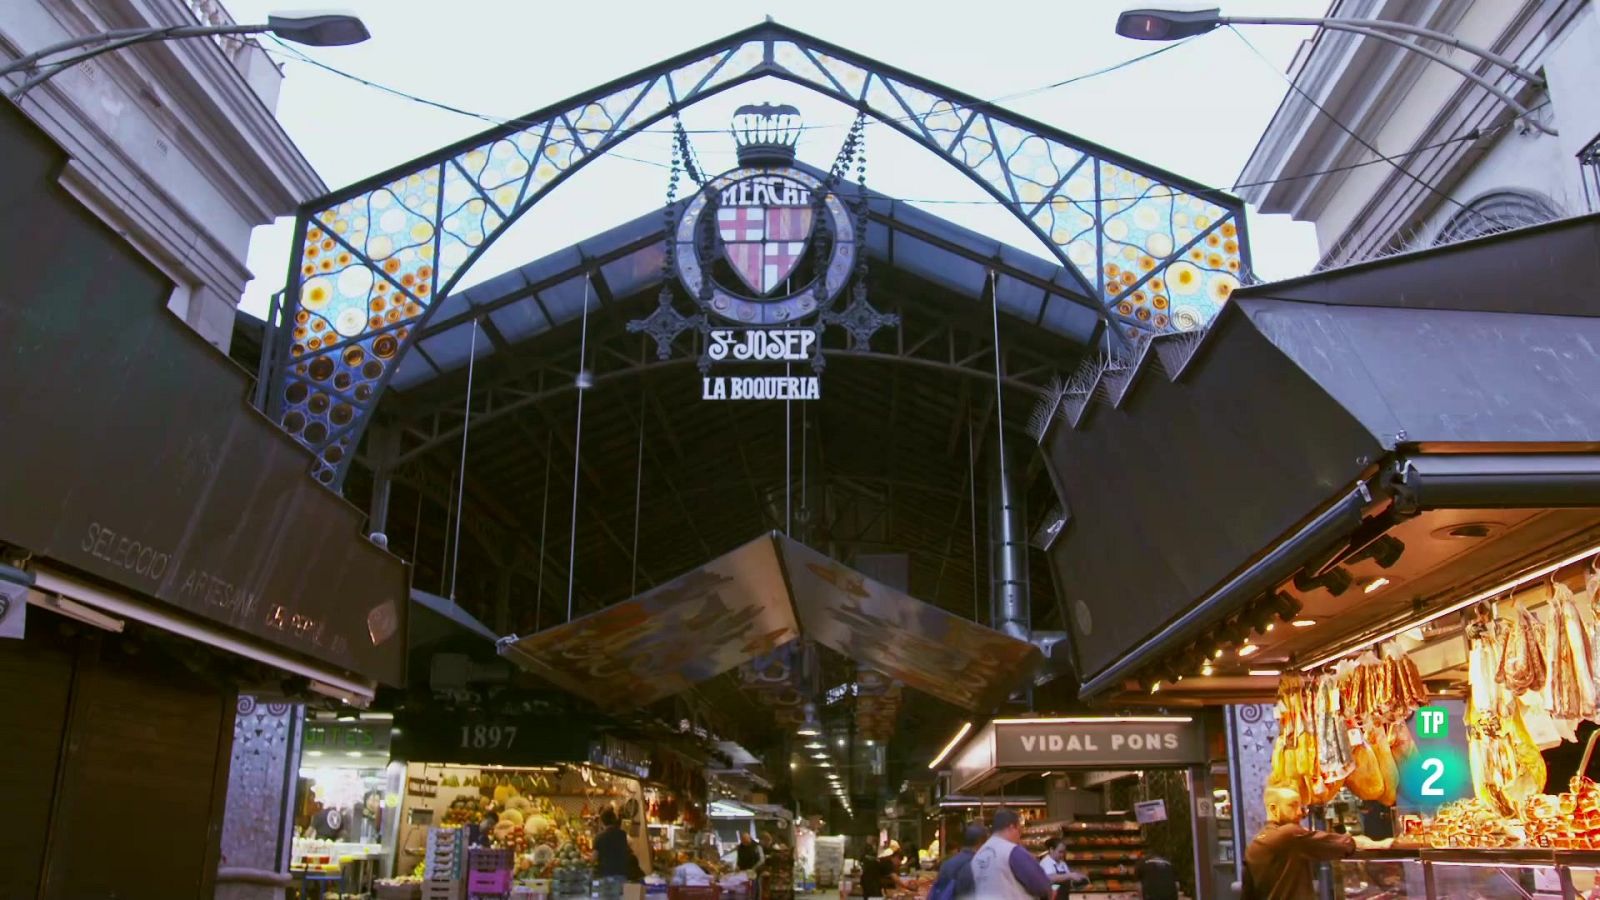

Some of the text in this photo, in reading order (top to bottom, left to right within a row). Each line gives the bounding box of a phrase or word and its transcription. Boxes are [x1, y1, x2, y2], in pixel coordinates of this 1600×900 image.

[721, 177, 811, 205] MERCAT
[733, 330, 816, 360] JOSEP
[702, 377, 820, 400] LA BOQUERIA
[459, 724, 518, 750] 1897
[1020, 733, 1179, 752] VIDAL PONS
